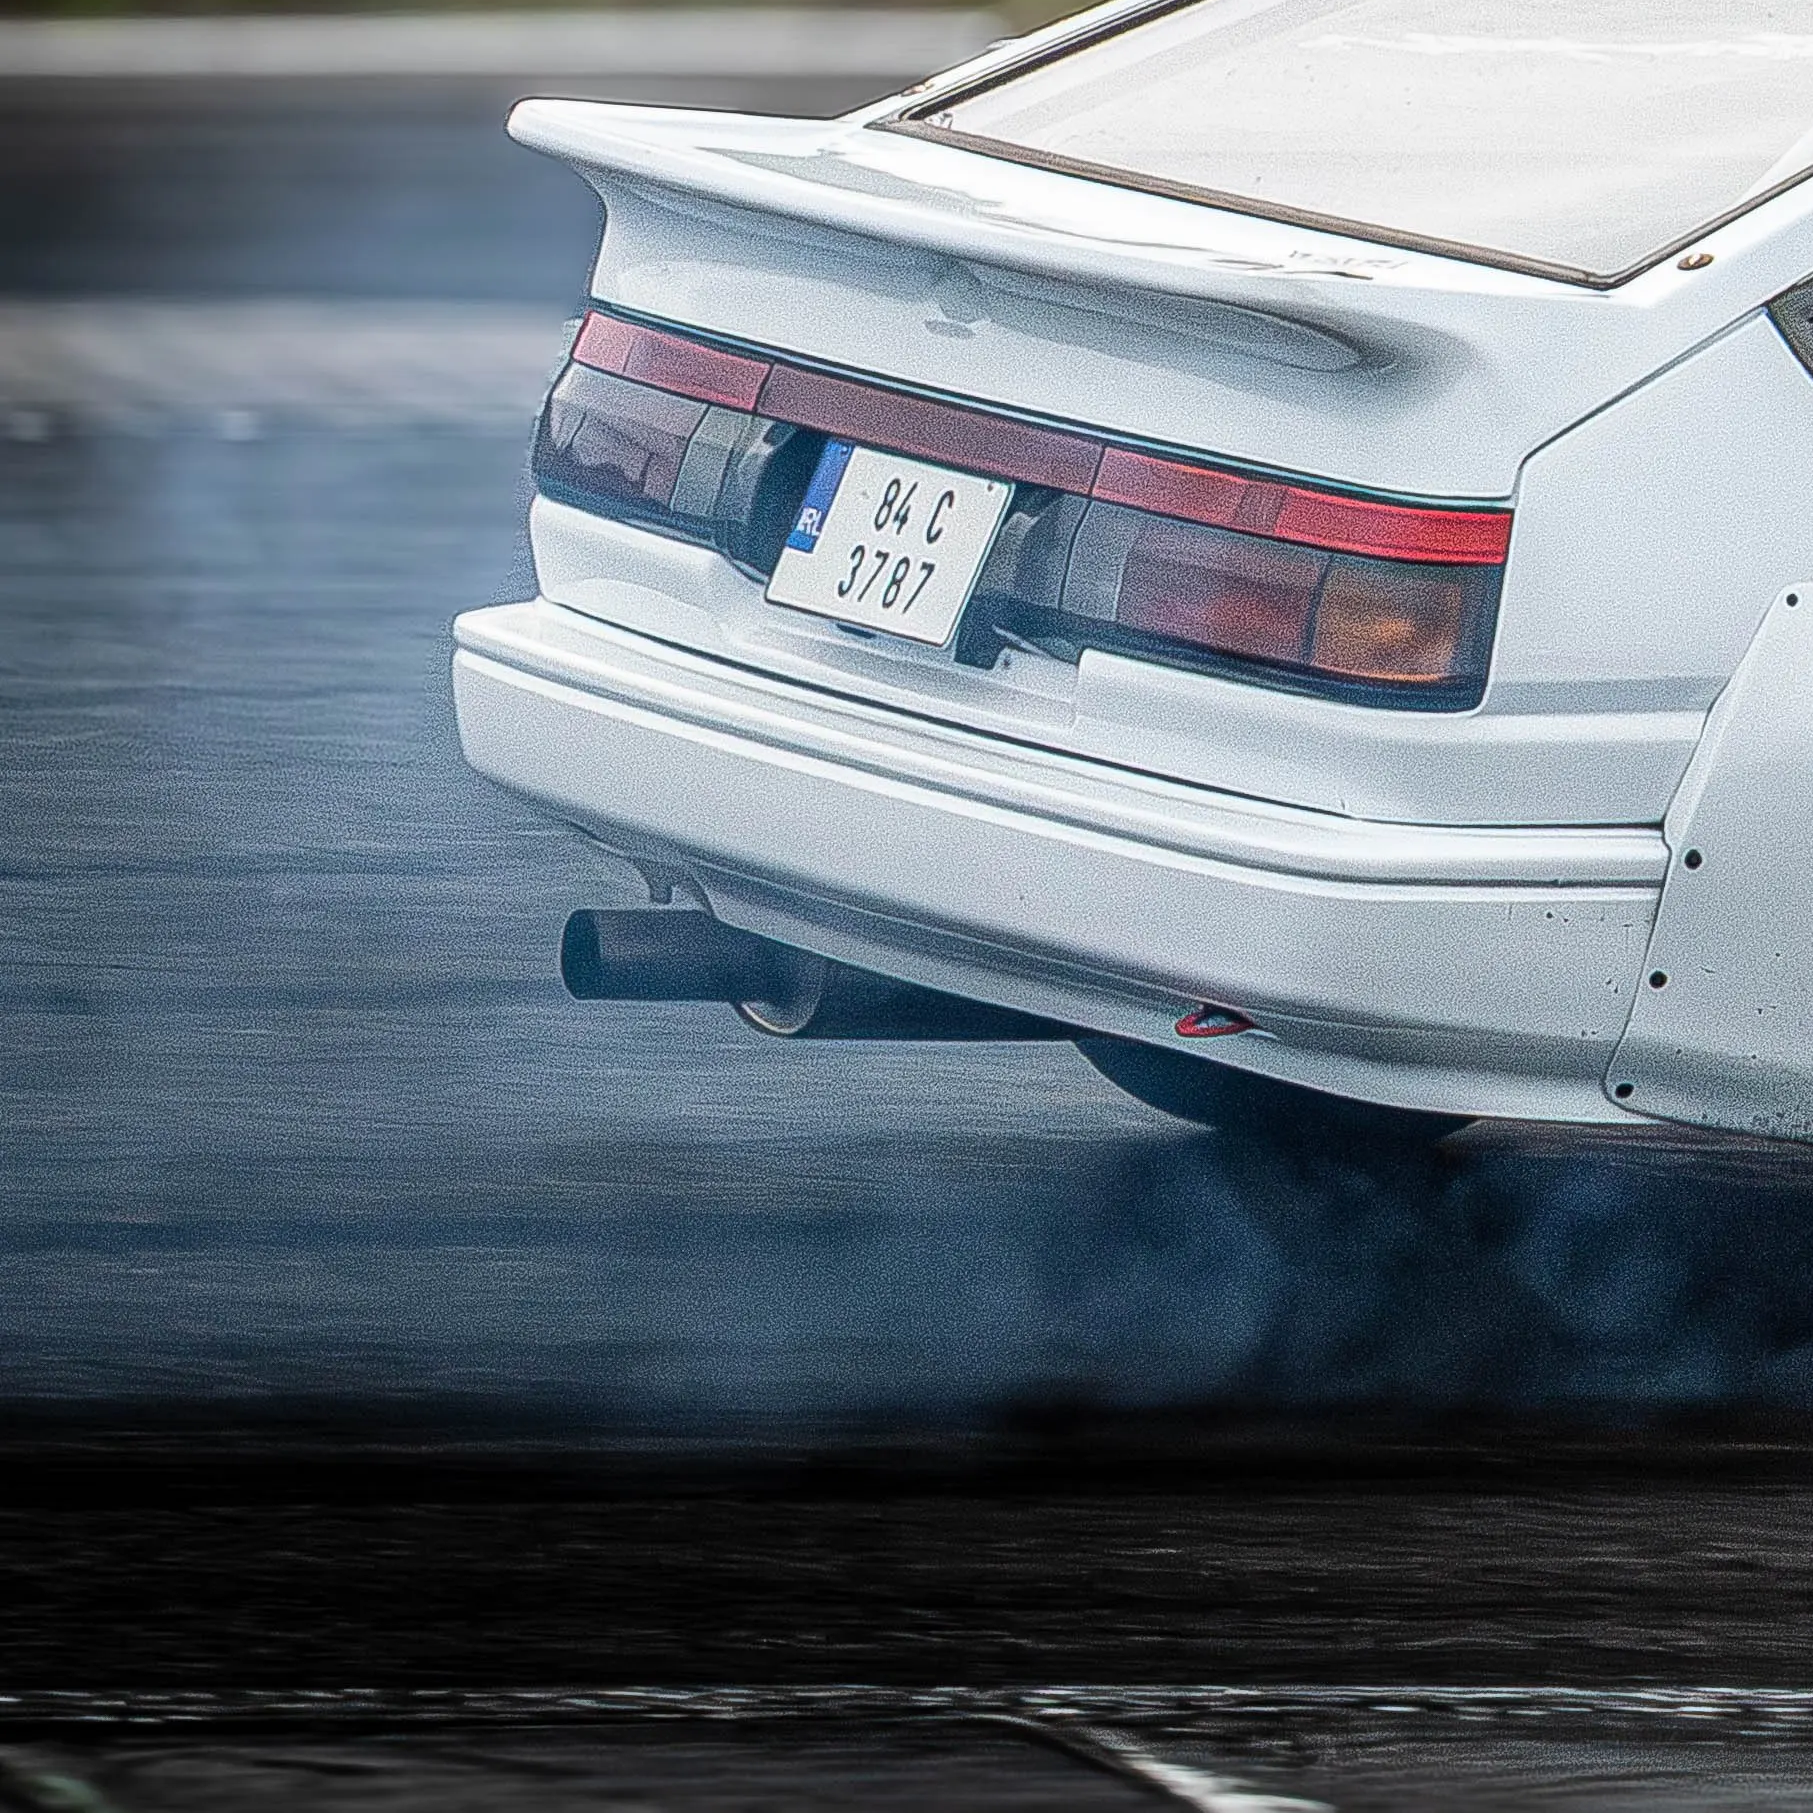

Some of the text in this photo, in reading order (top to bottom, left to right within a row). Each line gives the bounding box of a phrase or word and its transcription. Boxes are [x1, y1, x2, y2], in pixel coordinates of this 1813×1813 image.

[796, 506, 822, 537] IRL
[873, 477, 955, 545] 84 C
[837, 544, 936, 615] 3787
